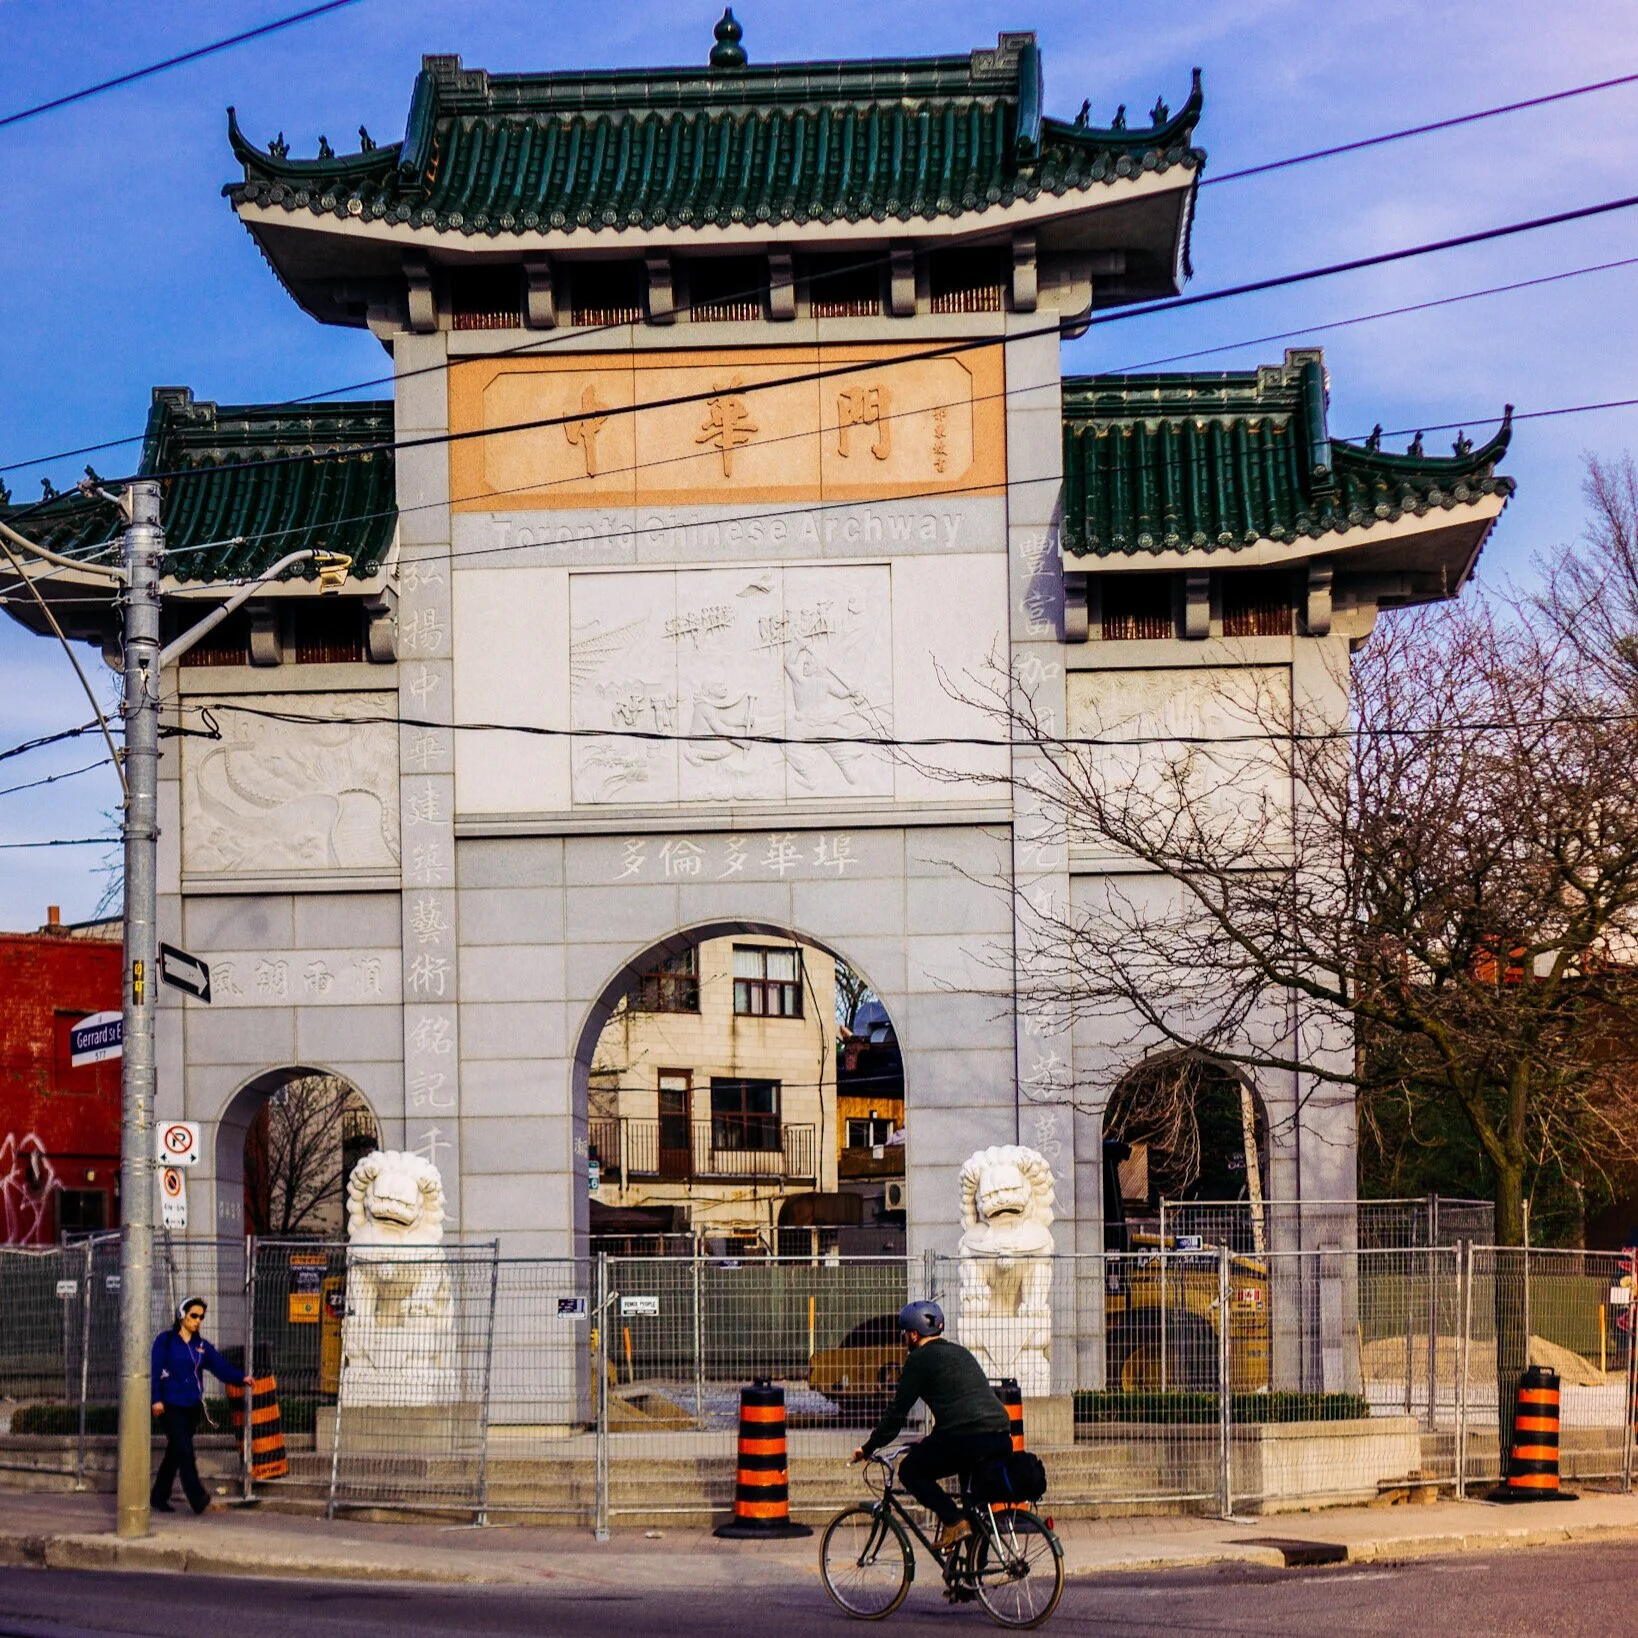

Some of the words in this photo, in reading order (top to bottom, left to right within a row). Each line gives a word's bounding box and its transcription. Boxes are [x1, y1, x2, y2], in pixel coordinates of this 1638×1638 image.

[491, 516, 635, 555] Toronto
[644, 513, 788, 548] Chinese
[798, 508, 964, 549] Archway
[612, 832, 858, 880] 多倫多華埠
[76, 1026, 108, 1049] Gerrard
[116, 1022, 122, 1040] E
